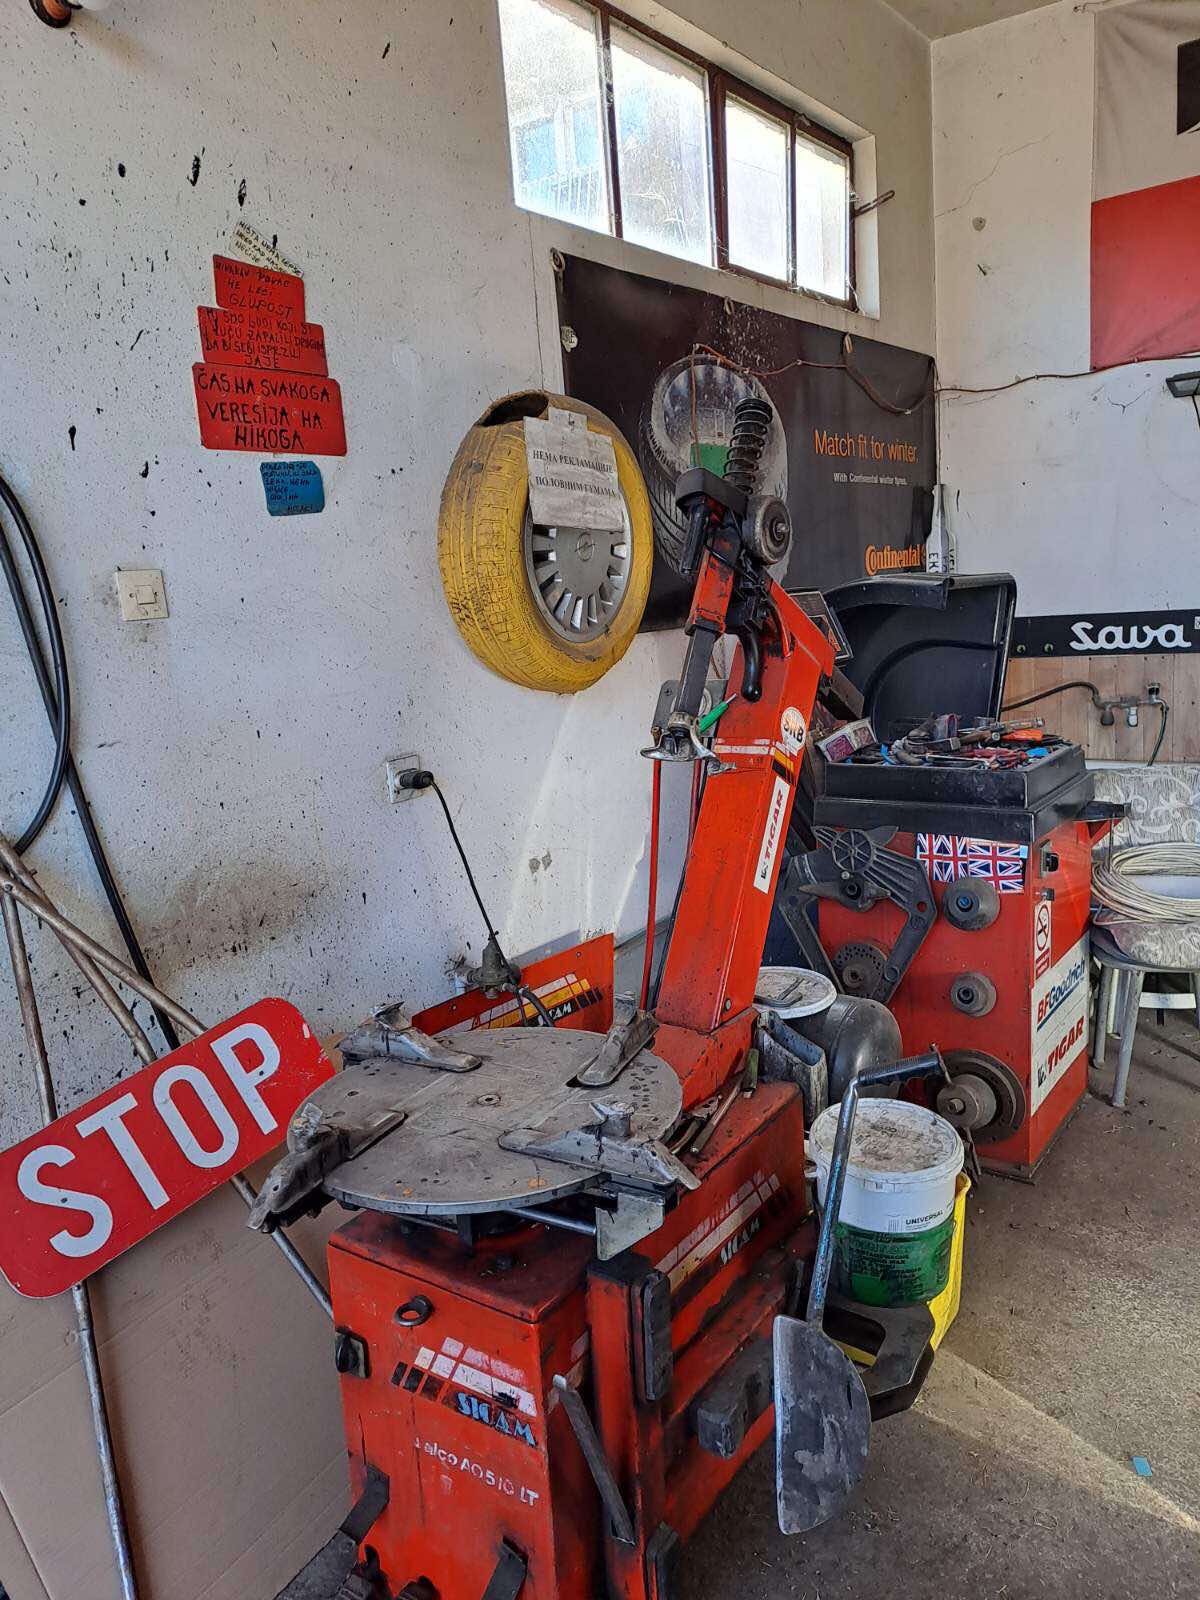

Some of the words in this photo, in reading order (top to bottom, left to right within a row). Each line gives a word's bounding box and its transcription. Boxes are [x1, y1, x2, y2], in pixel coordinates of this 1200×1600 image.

[229, 293, 293, 319] GLUPOST
[260, 378, 330, 403] SVAKOGA
[814, 429, 855, 456] Match
[858, 434, 868, 460] fit
[871, 435, 884, 463] for
[887, 439, 919, 464] winter.
[833, 472, 848, 482] With
[865, 543, 921, 576] Continental
[1069, 621, 1192, 651] Sava
[764, 789, 784, 860] TIGAR
[1036, 956, 1086, 1026] BFGoodrich
[1048, 1016, 1085, 1075] TIGAR
[17, 1022, 281, 1258] STOP
[905, 1210, 943, 1225] UNIVERSAL
